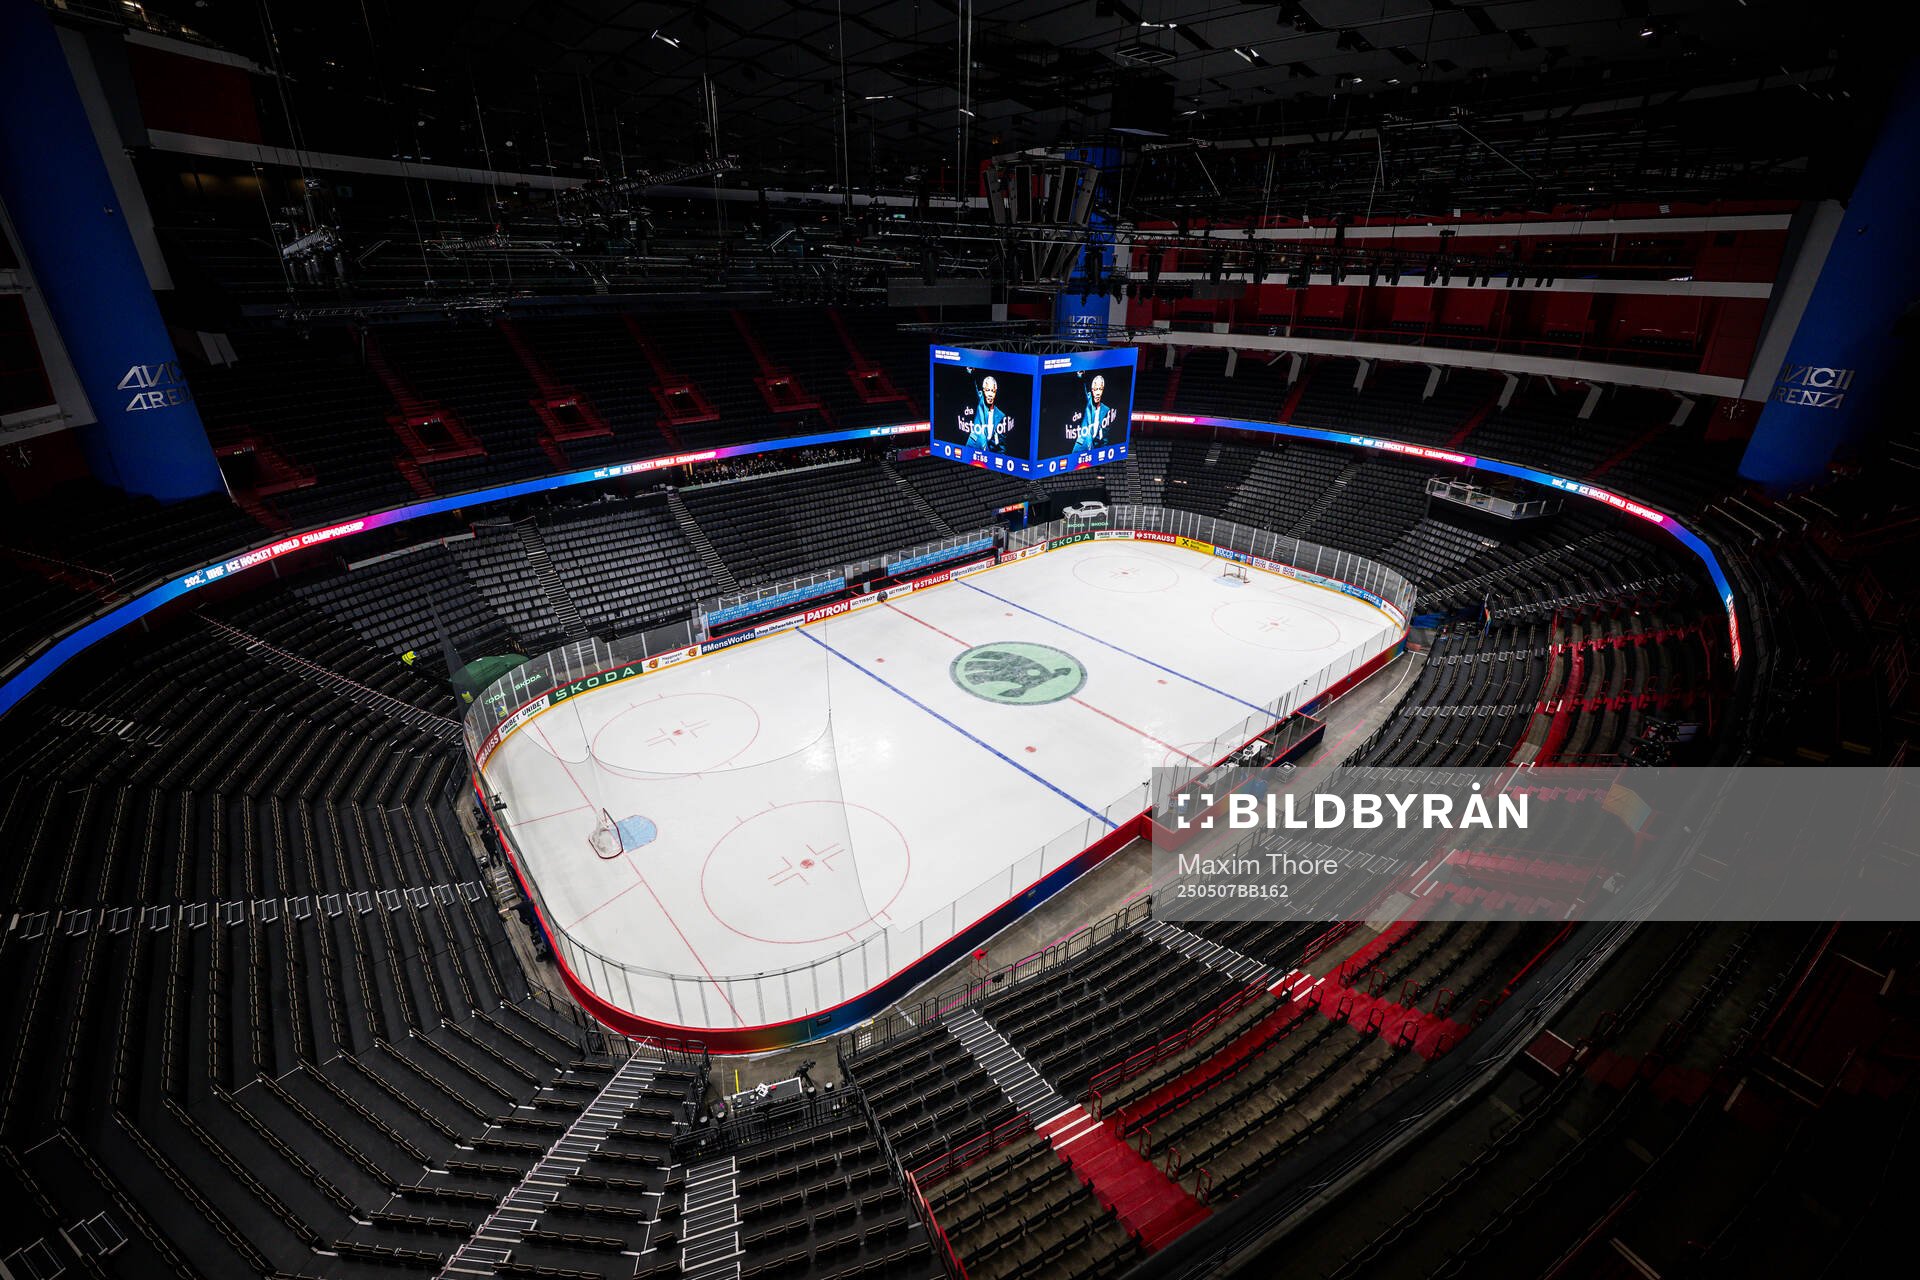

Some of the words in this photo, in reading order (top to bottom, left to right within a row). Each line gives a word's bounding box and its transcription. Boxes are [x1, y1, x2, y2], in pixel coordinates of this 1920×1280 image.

[958, 415, 994, 440] history
[997, 416, 1006, 434] of
[1065, 421, 1098, 439] history
[1102, 413, 1110, 428] of
[945, 445, 951, 456] 0
[1108, 448, 1114, 459] 0
[1007, 460, 1014, 471] 0
[1049, 461, 1056, 472] 0
[1143, 532, 1175, 543] STRAUSS
[226, 559, 241, 573] ICE
[241, 548, 272, 568] HOCKEY
[272, 538, 300, 554] WORLD
[302, 521, 364, 545] CHAMPIONSHIP
[920, 573, 949, 587] STRAUSS
[807, 602, 849, 622] PATRON
[702, 632, 755, 653] #MensWorlds
[522, 698, 545, 716] UNIBET
[500, 714, 520, 733] UNIBET
